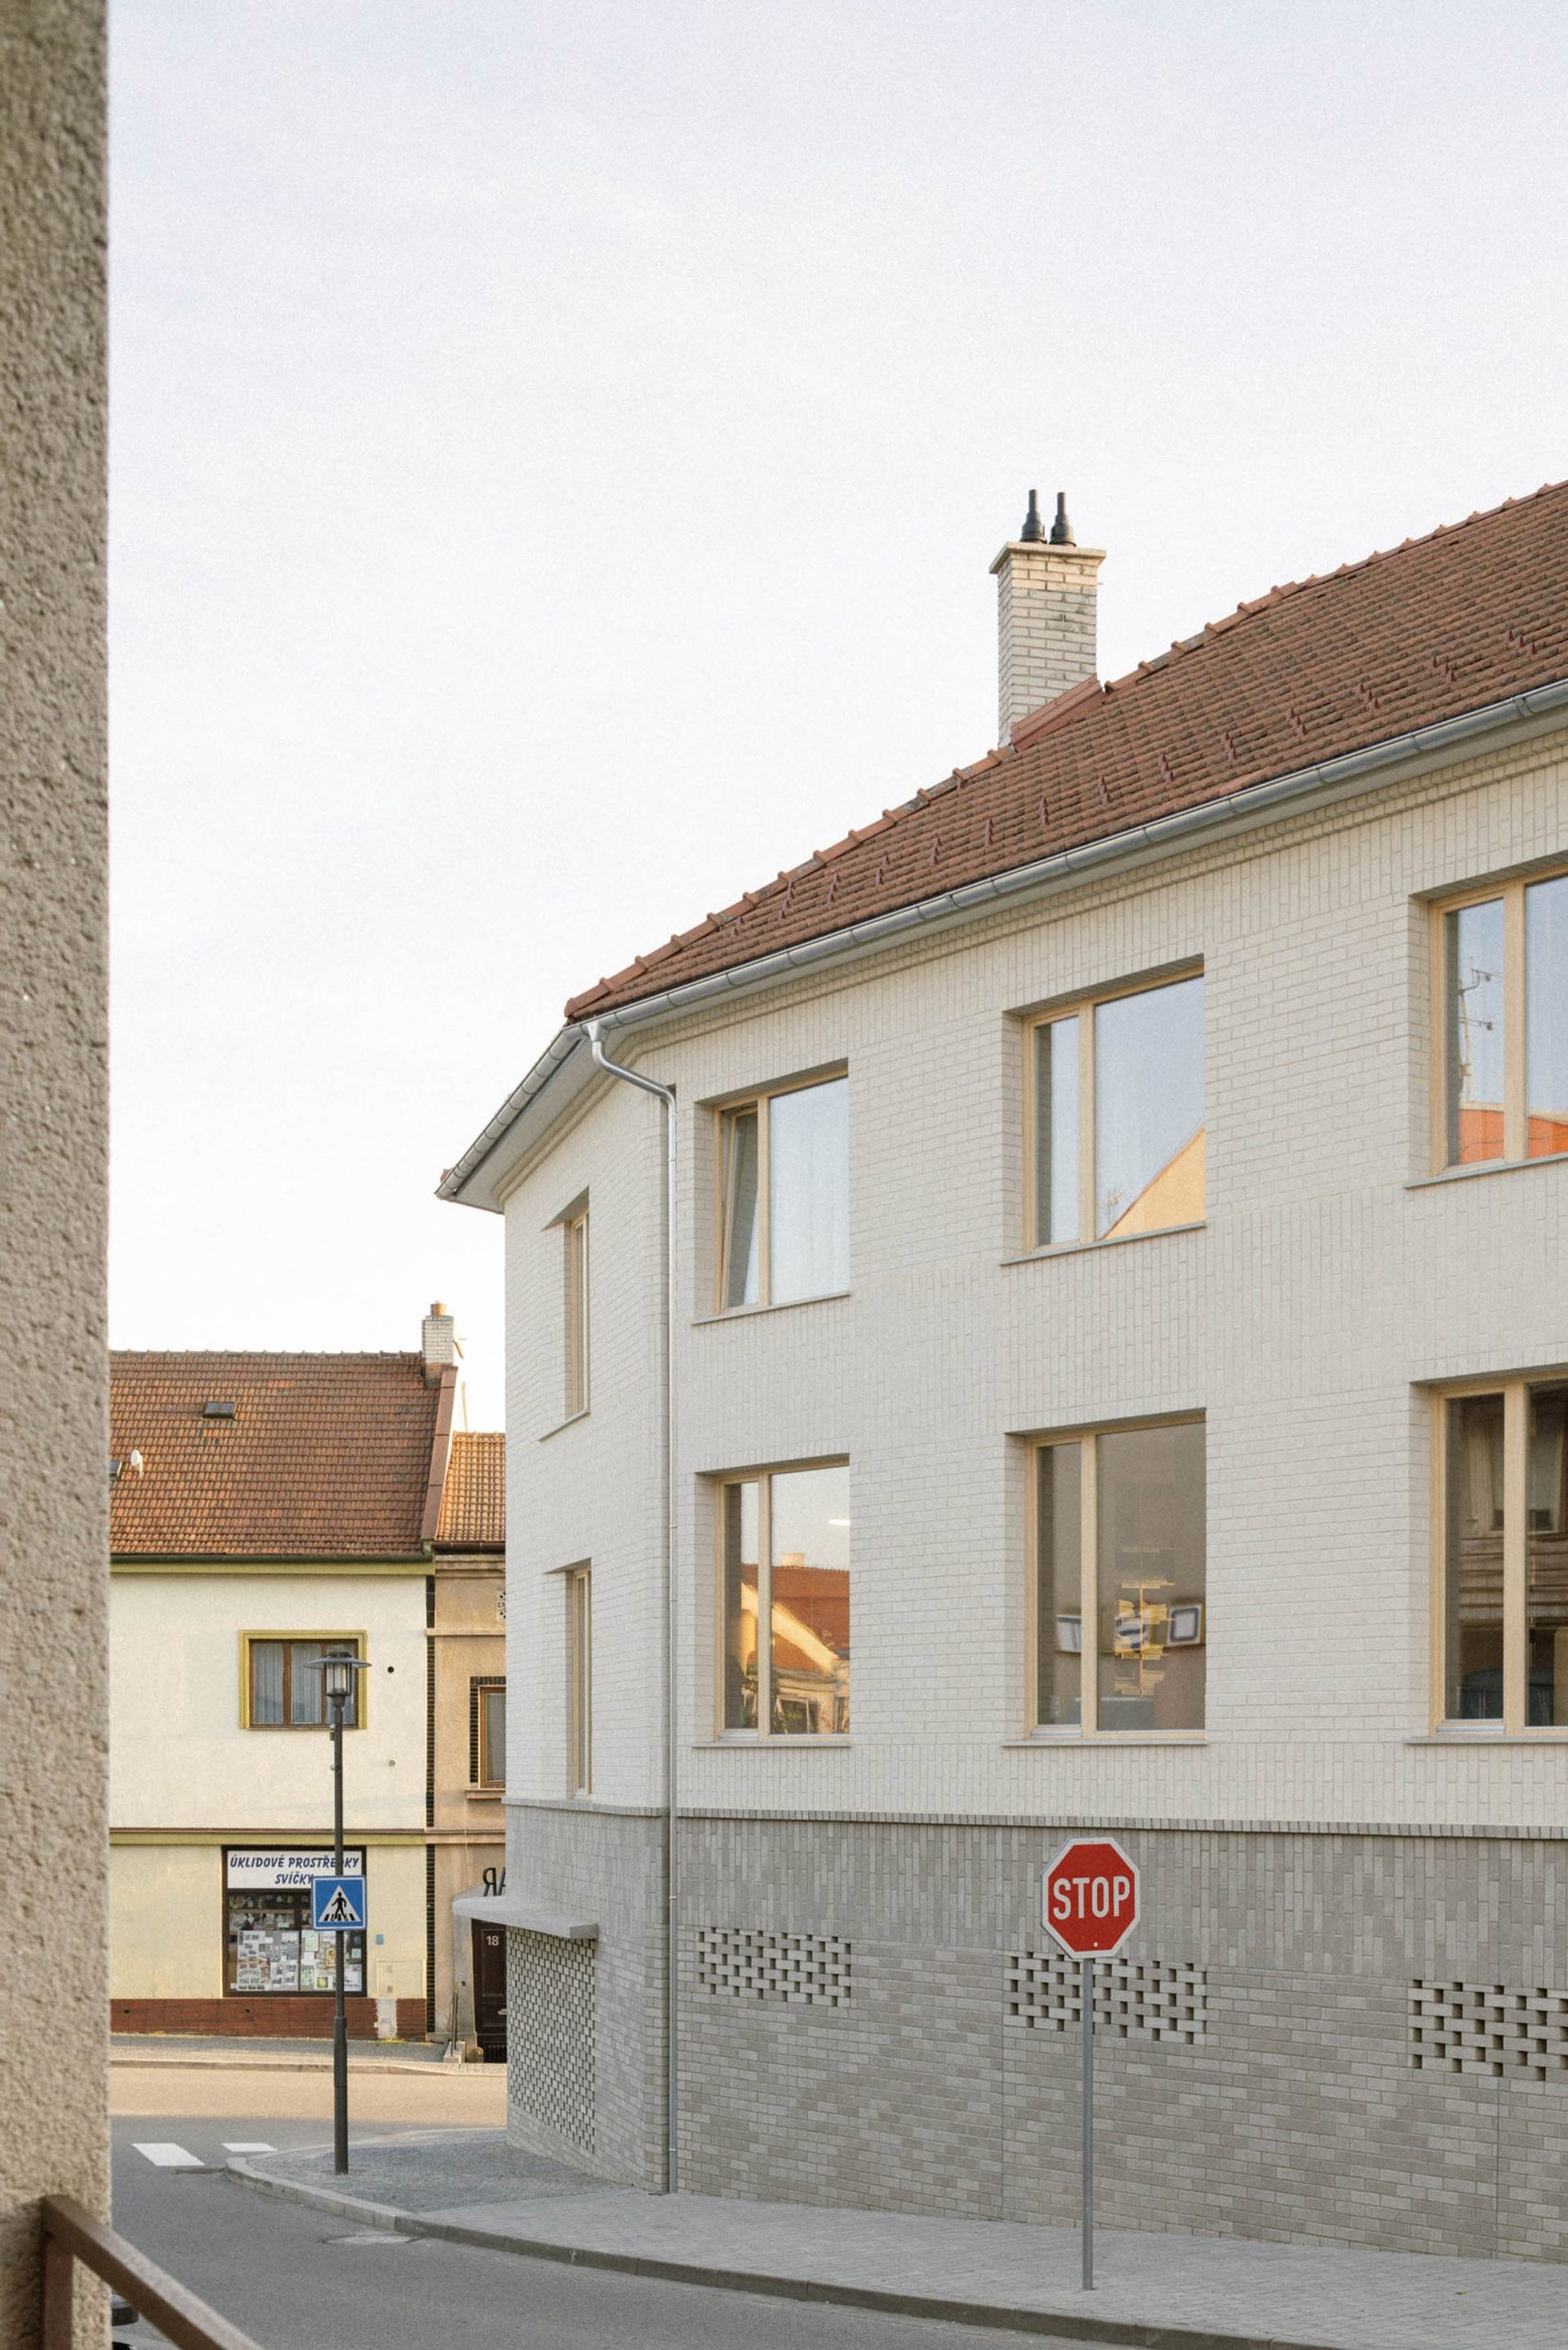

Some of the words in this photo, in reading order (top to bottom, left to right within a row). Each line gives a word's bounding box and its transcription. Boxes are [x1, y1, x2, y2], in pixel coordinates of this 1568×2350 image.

[230, 1854, 285, 1868] ÚKLIDOVÉ
[287, 1854, 359, 1868] PROSTŘEKY
[274, 1871, 314, 1885] SVÍČKY
[1053, 1876, 1130, 1920] STOP
[486, 1935, 499, 1946] 18
